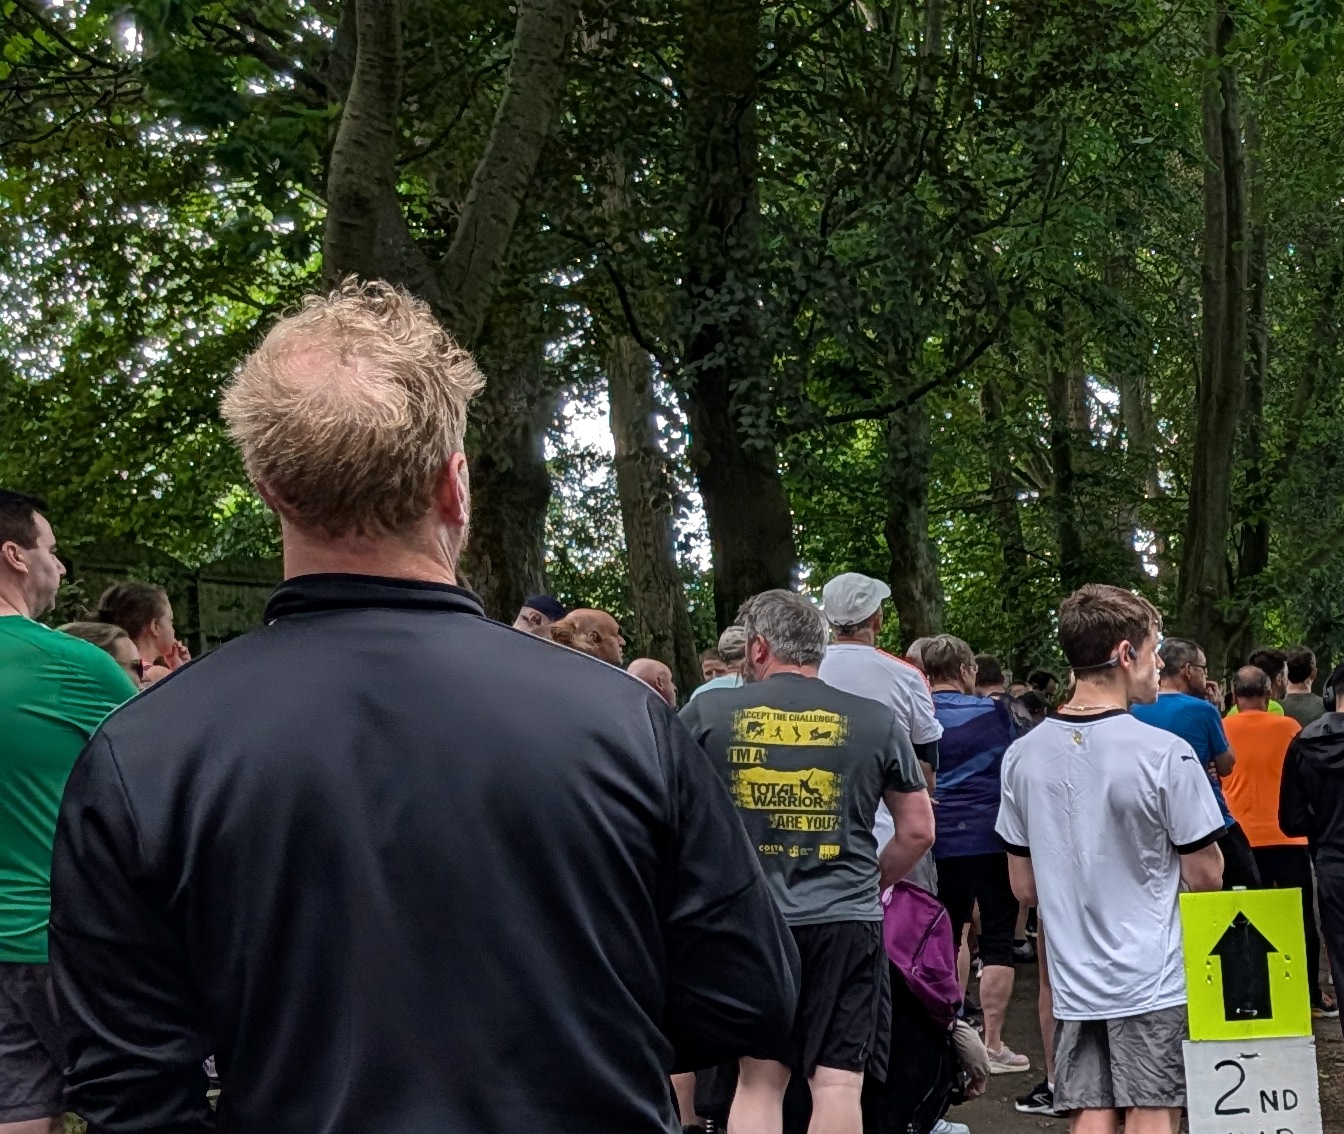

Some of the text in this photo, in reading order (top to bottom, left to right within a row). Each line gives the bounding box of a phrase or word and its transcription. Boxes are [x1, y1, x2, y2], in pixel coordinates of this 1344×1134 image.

[741, 710, 836, 723] ACCEPT THE CHALLENGE
[753, 748, 764, 762] A
[747, 782, 798, 796] TOTAL
[752, 796, 824, 809] WARRIOR
[776, 815, 840, 830] ARE YOU?
[759, 844, 784, 852] COSTA
